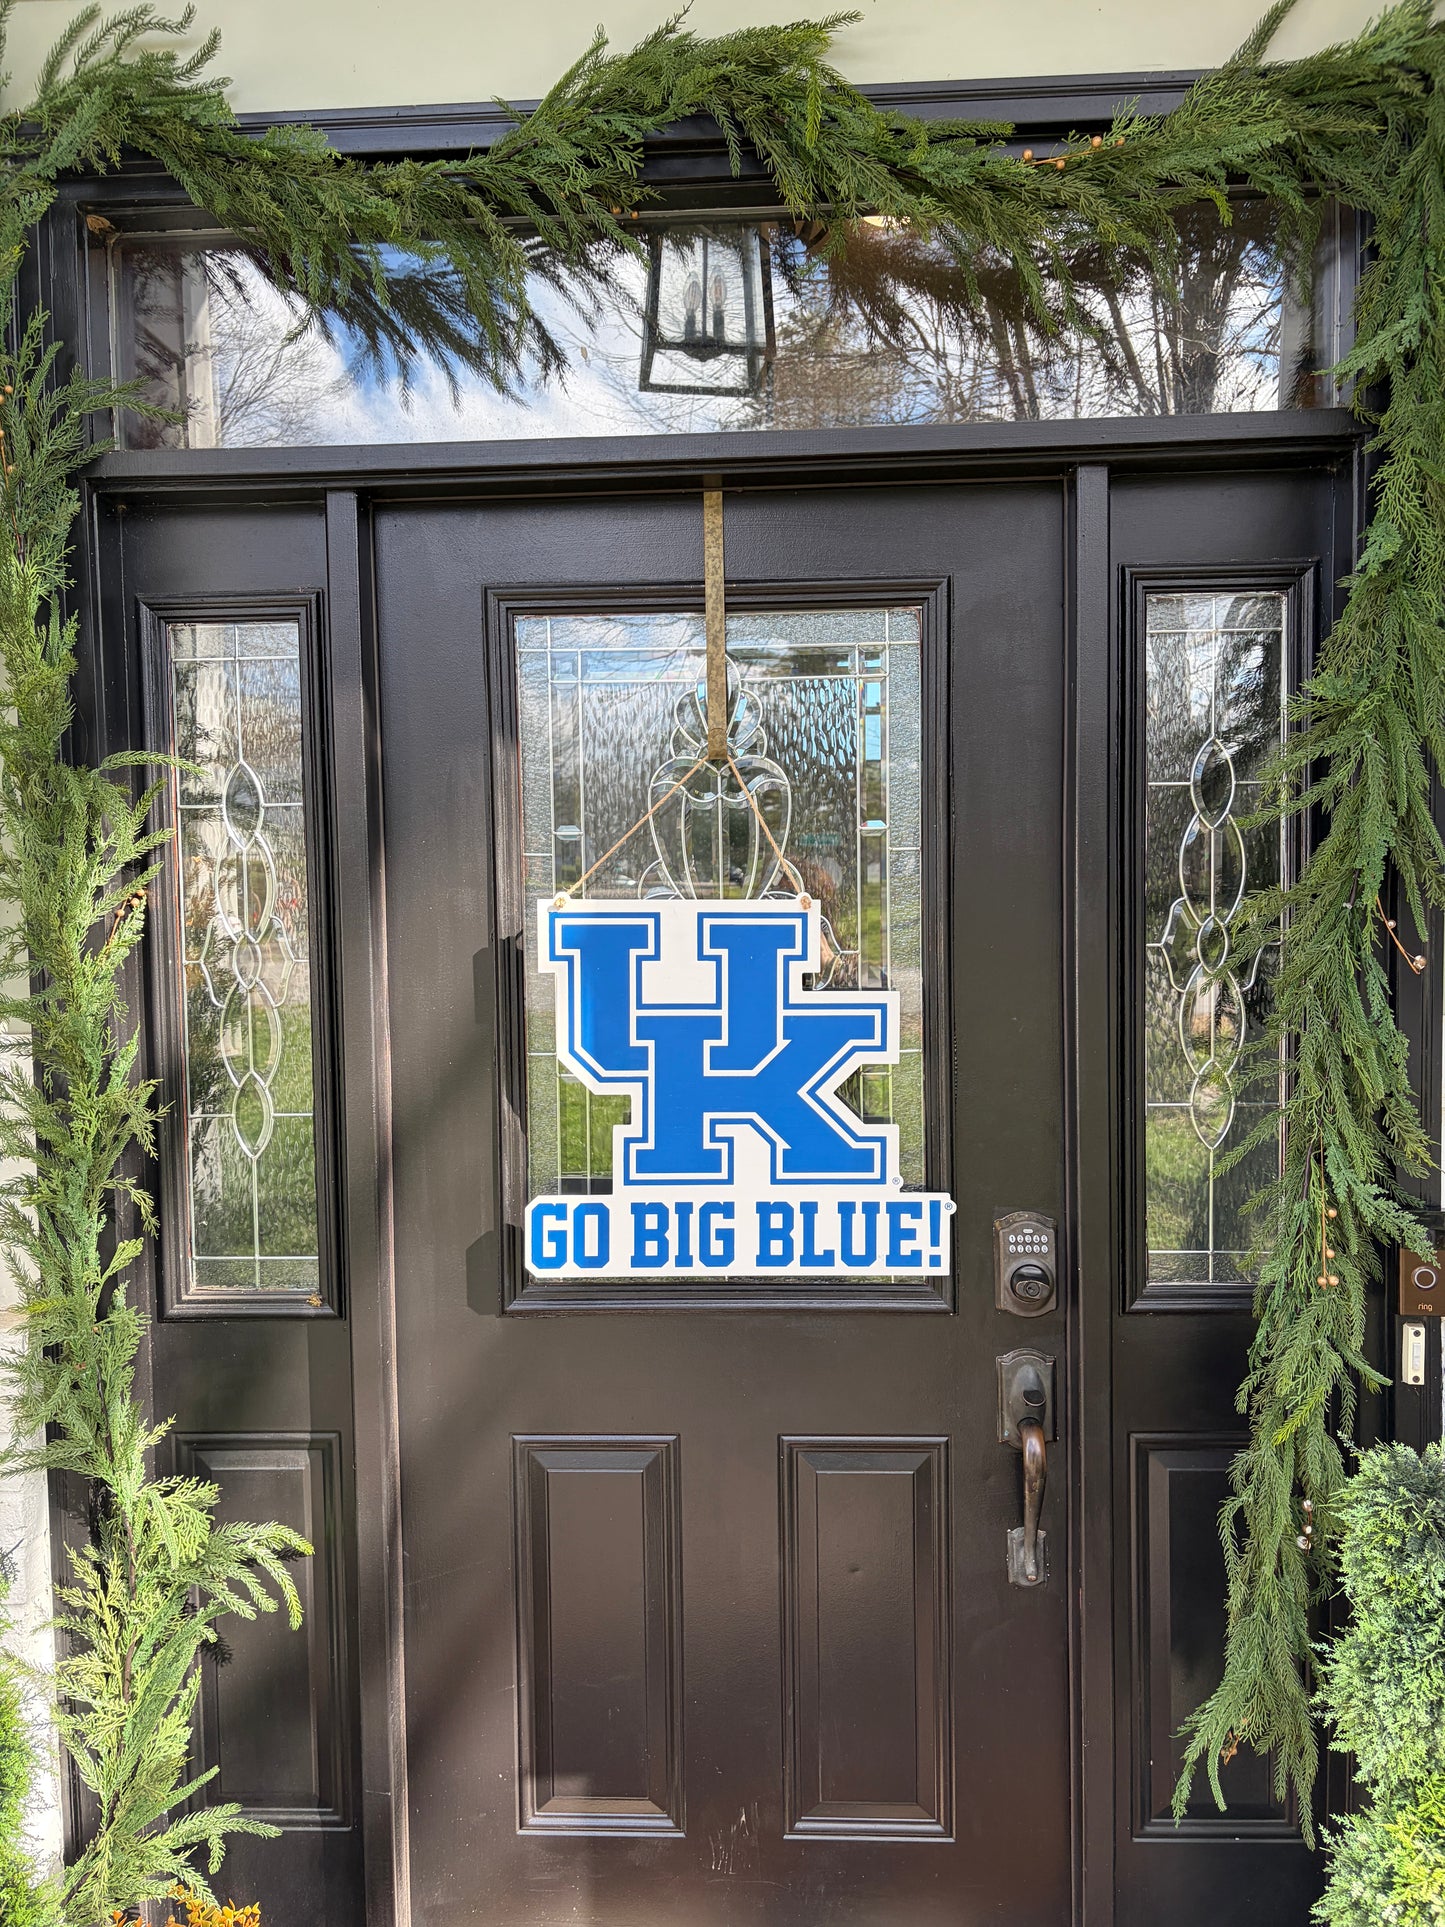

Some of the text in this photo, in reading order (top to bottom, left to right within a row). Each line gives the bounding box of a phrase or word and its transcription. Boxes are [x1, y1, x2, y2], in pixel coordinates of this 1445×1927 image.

[549, 912, 888, 1186] UK
[531, 1200, 942, 1269] GO BIG BLUE!
[1417, 1302, 1433, 1313] ring
